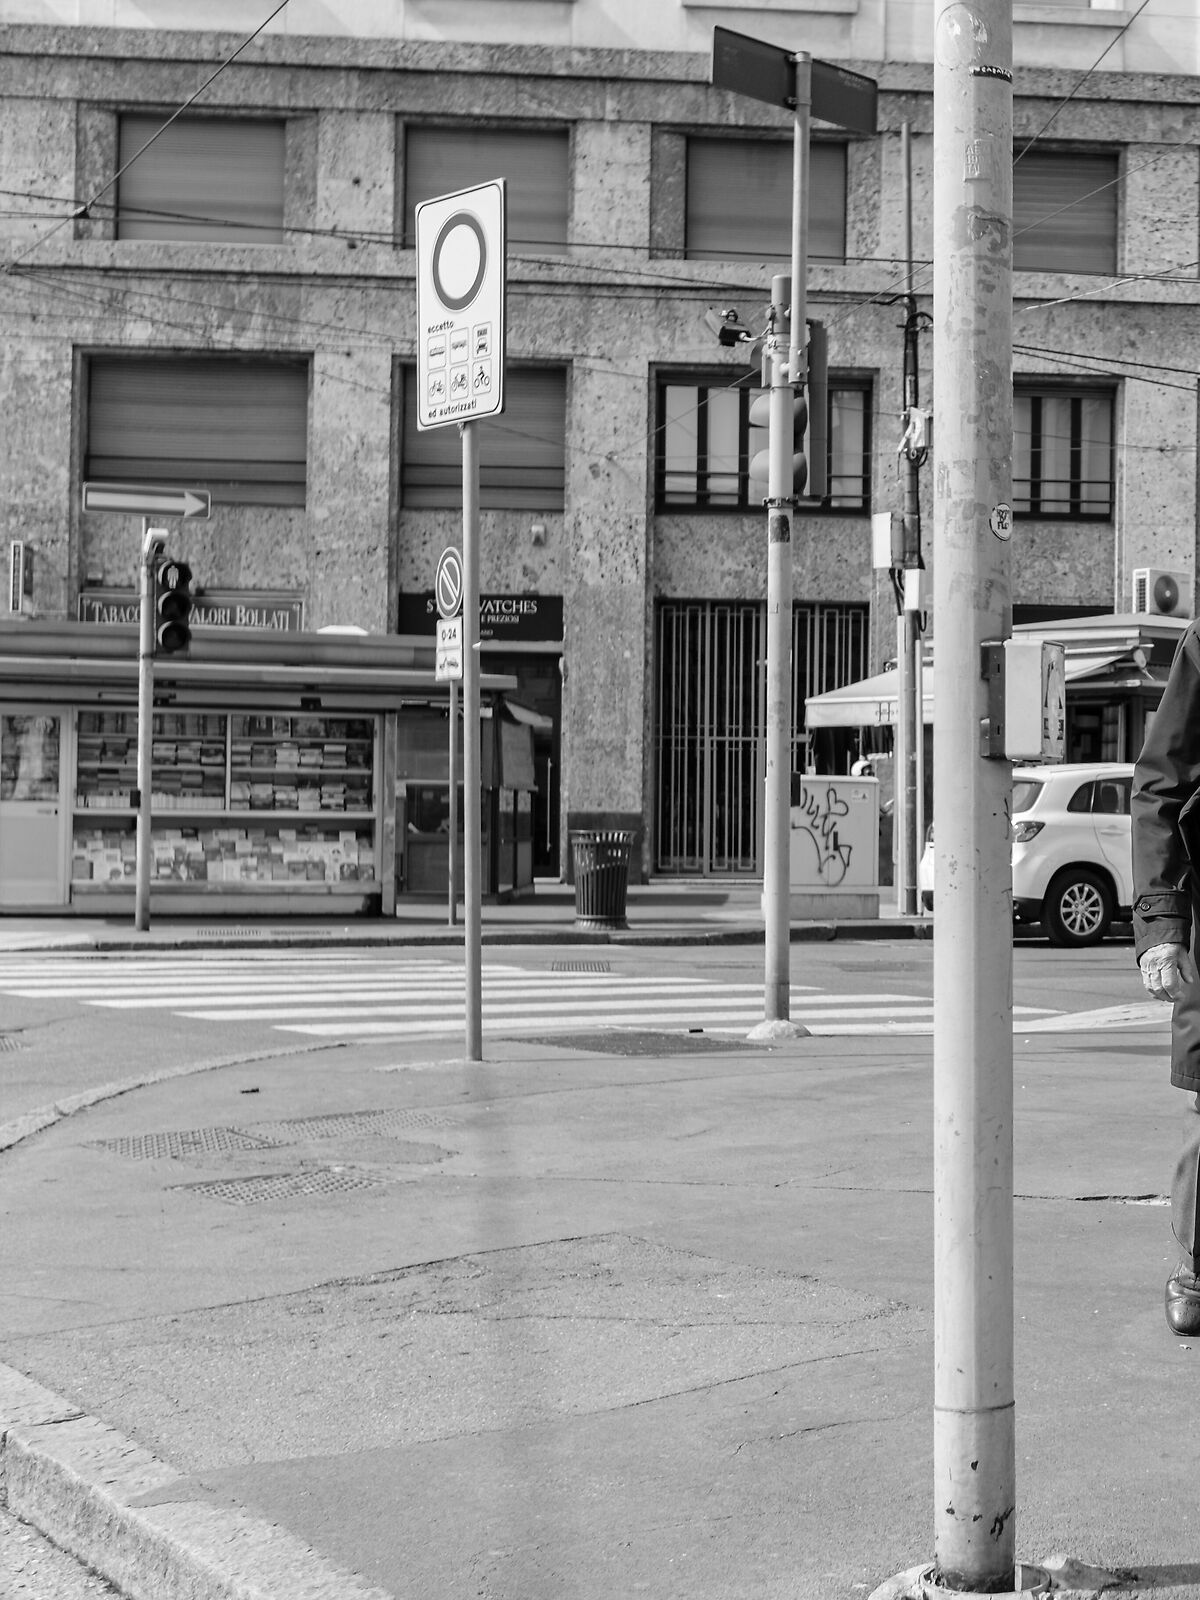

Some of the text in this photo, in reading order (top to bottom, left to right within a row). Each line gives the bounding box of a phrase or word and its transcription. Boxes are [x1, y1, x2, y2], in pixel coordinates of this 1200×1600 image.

[427, 320, 454, 334] eccetto
[428, 398, 477, 418] ed autorizzati
[235, 604, 290, 632] BOLLATI
[487, 614, 520, 624] PREZIOSI
[441, 628, 457, 641] 0-24
